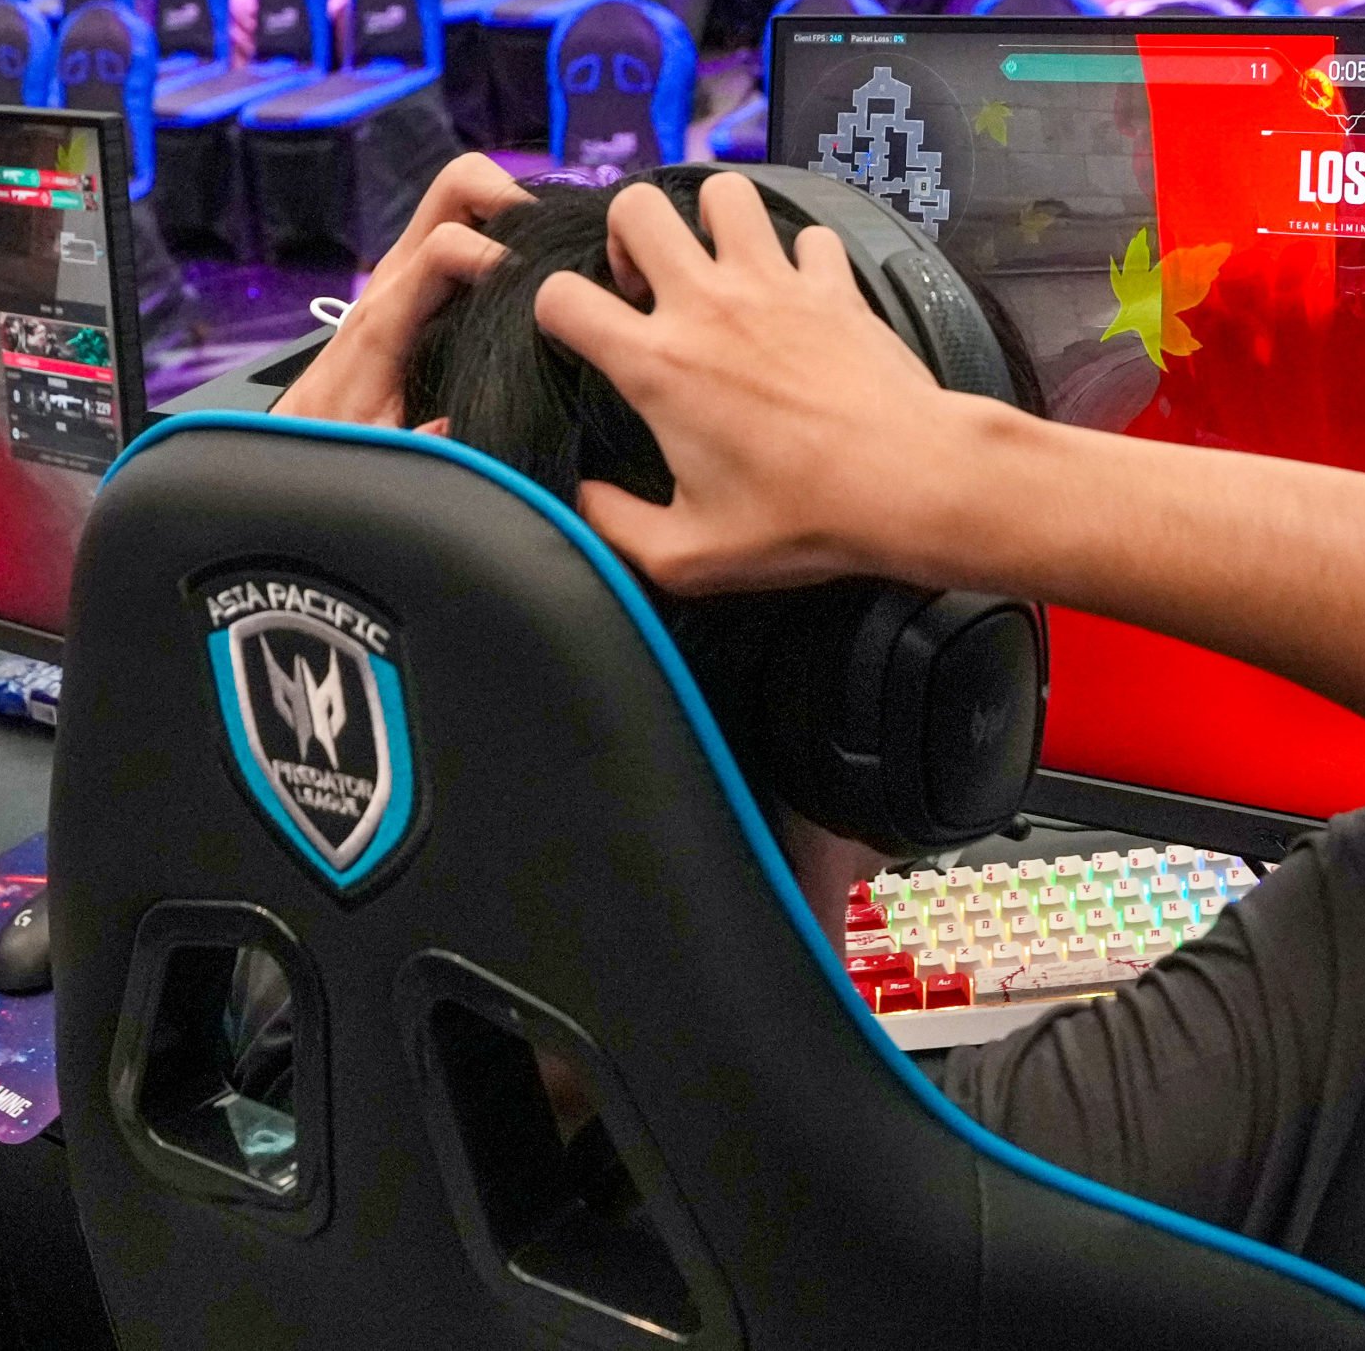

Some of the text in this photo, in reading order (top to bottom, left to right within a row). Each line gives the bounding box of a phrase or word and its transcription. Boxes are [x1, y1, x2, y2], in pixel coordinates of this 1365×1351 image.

[794, 34, 812, 42] Client
[829, 34, 842, 42] 240
[851, 34, 873, 43] Packet
[1250, 62, 1268, 79] 11
[1289, 220, 1320, 230] TEAM
[207, 581, 391, 655] ASIA PACIFIC
[272, 758, 374, 800] PREDATOR
[293, 785, 362, 818] LEAGUE
